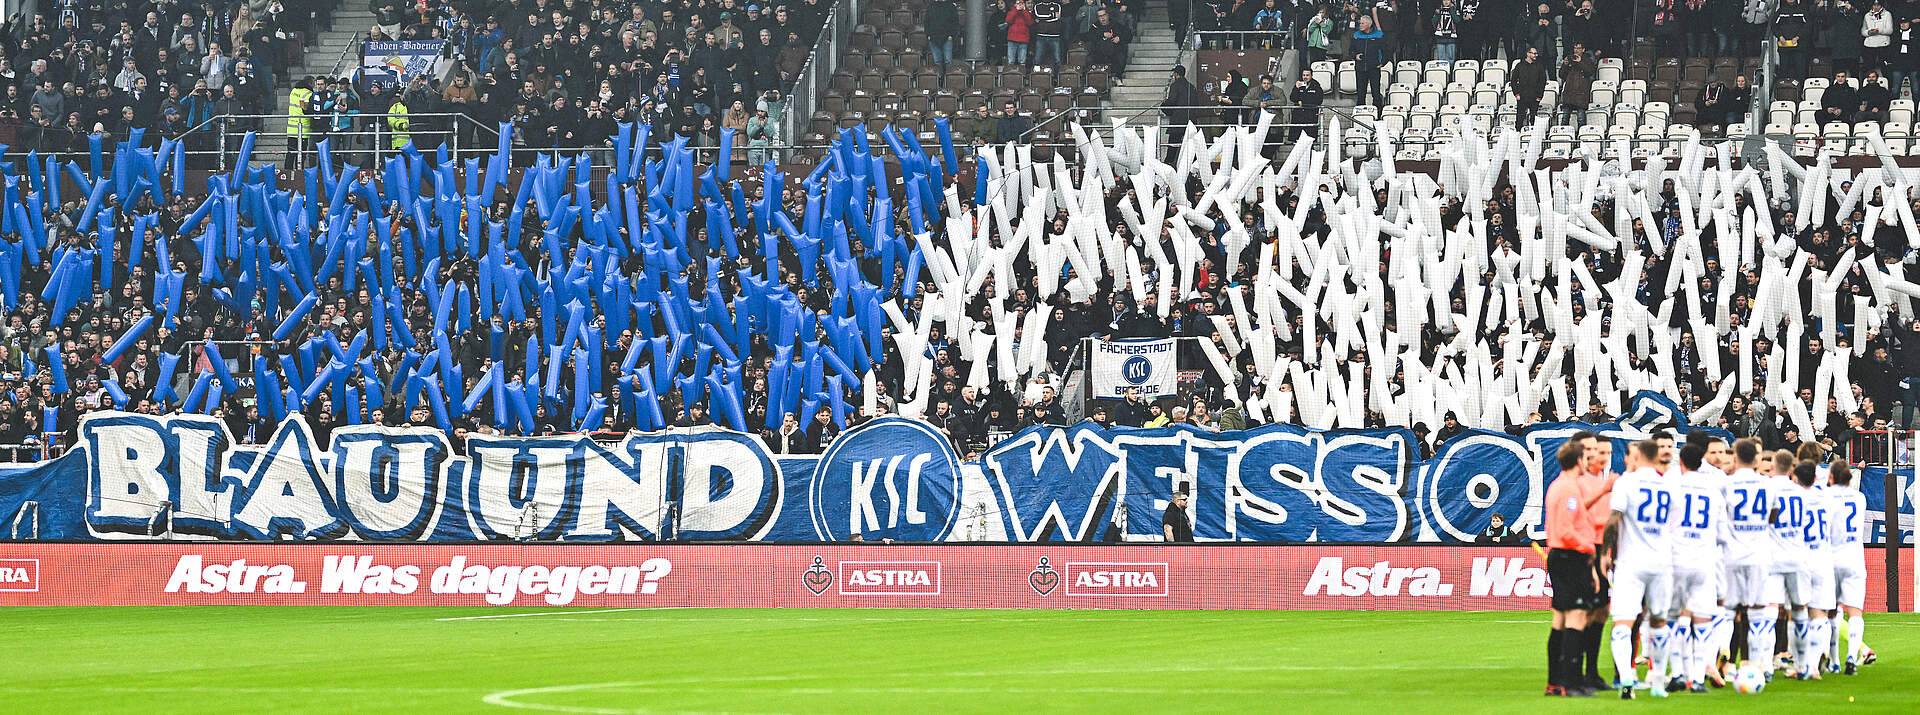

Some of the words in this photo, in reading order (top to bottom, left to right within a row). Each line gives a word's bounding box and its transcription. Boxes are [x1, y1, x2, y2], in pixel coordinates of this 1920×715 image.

[1100, 342, 1173, 355] FÄCHERSTADT
[1129, 360, 1146, 379] KSC
[88, 414, 446, 541] BLAU
[470, 434, 778, 541] UND
[851, 452, 932, 532] KSC
[988, 428, 1410, 541] WEISS
[1637, 487, 1671, 524] 28
[1680, 493, 1710, 529] 13
[1733, 488, 1768, 521] 24
[1774, 496, 1803, 529] 20
[1844, 501, 1857, 533] 2
[163, 554, 306, 595] Astra.
[320, 554, 421, 595] Was
[430, 554, 672, 605] dagegen?
[848, 570, 931, 587] ASTRA
[1074, 571, 1158, 588] ASTRA
[1302, 556, 1454, 597] Astra.
